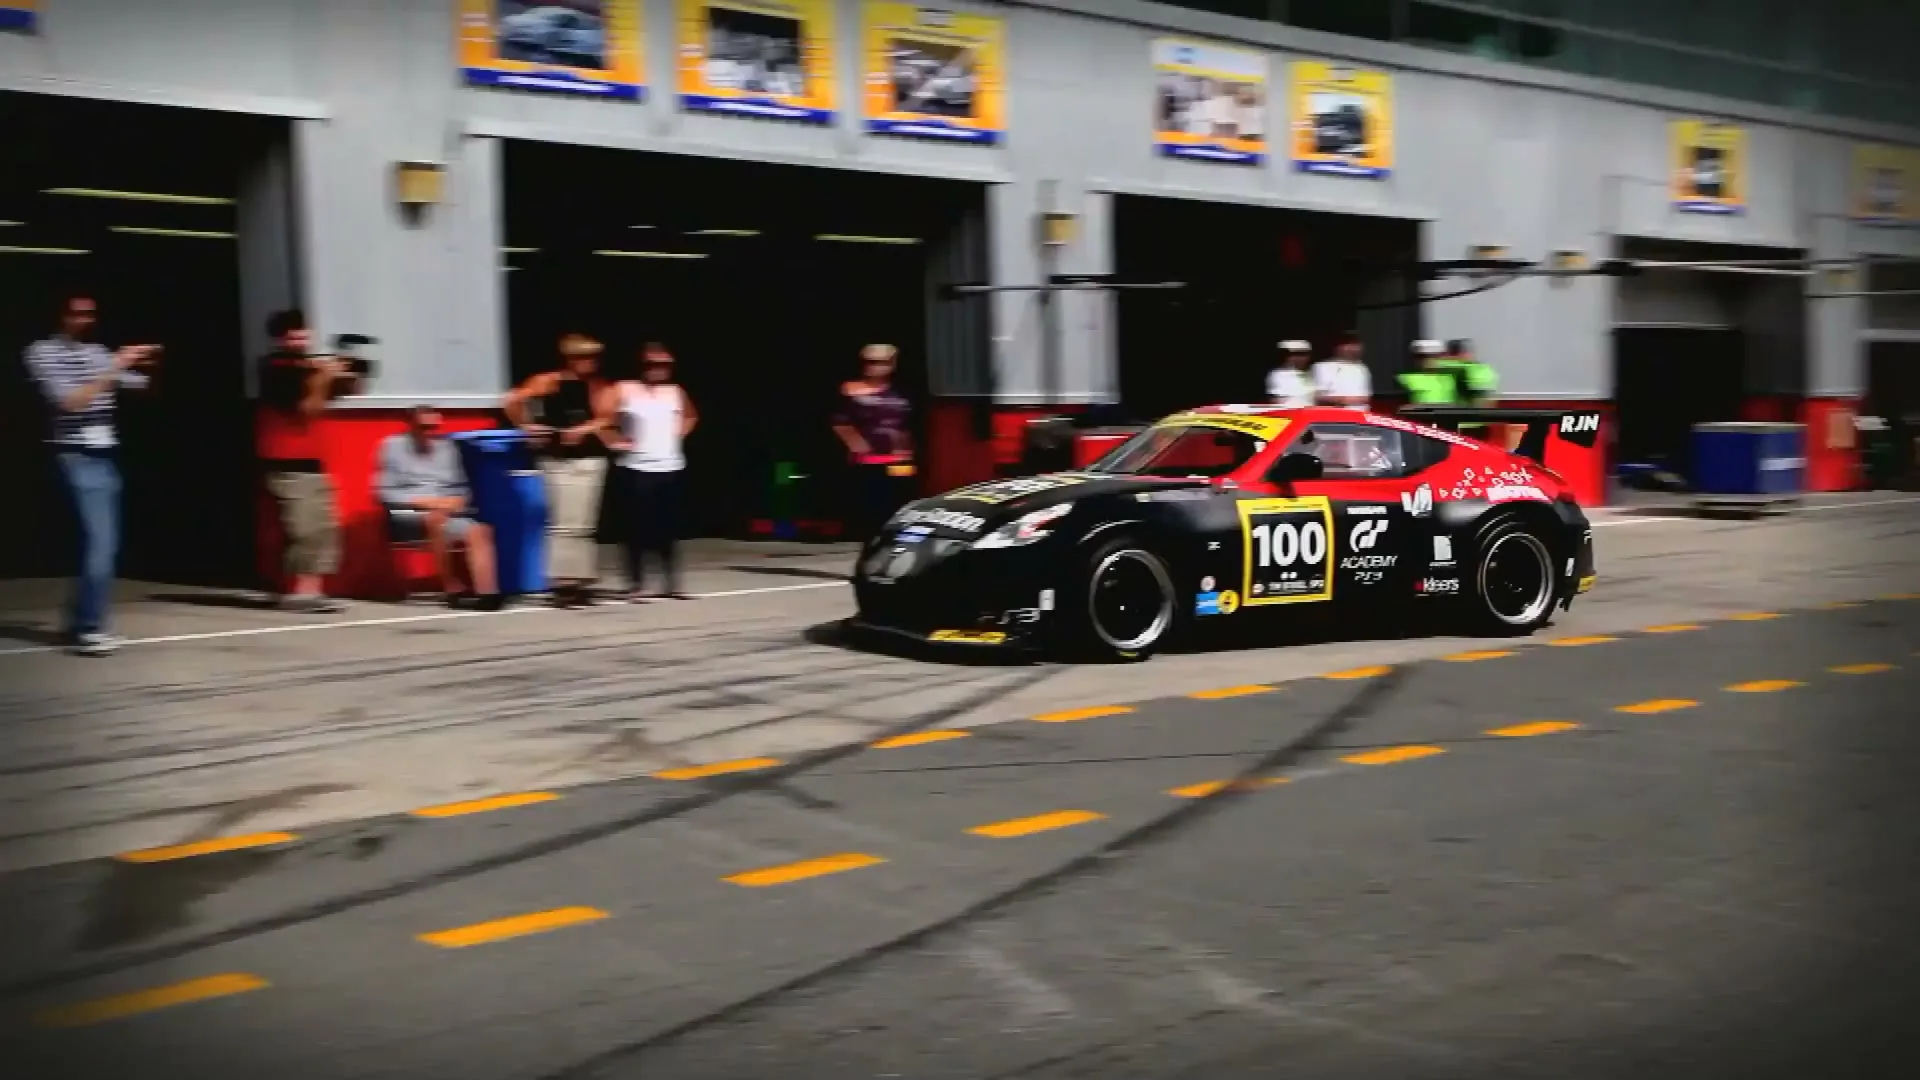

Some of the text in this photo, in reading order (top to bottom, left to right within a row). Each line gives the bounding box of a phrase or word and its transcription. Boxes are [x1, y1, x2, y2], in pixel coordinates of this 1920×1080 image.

[1560, 414, 1600, 433] RJN
[1252, 521, 1326, 567] 100
[1340, 555, 1398, 569] ACADEMY
